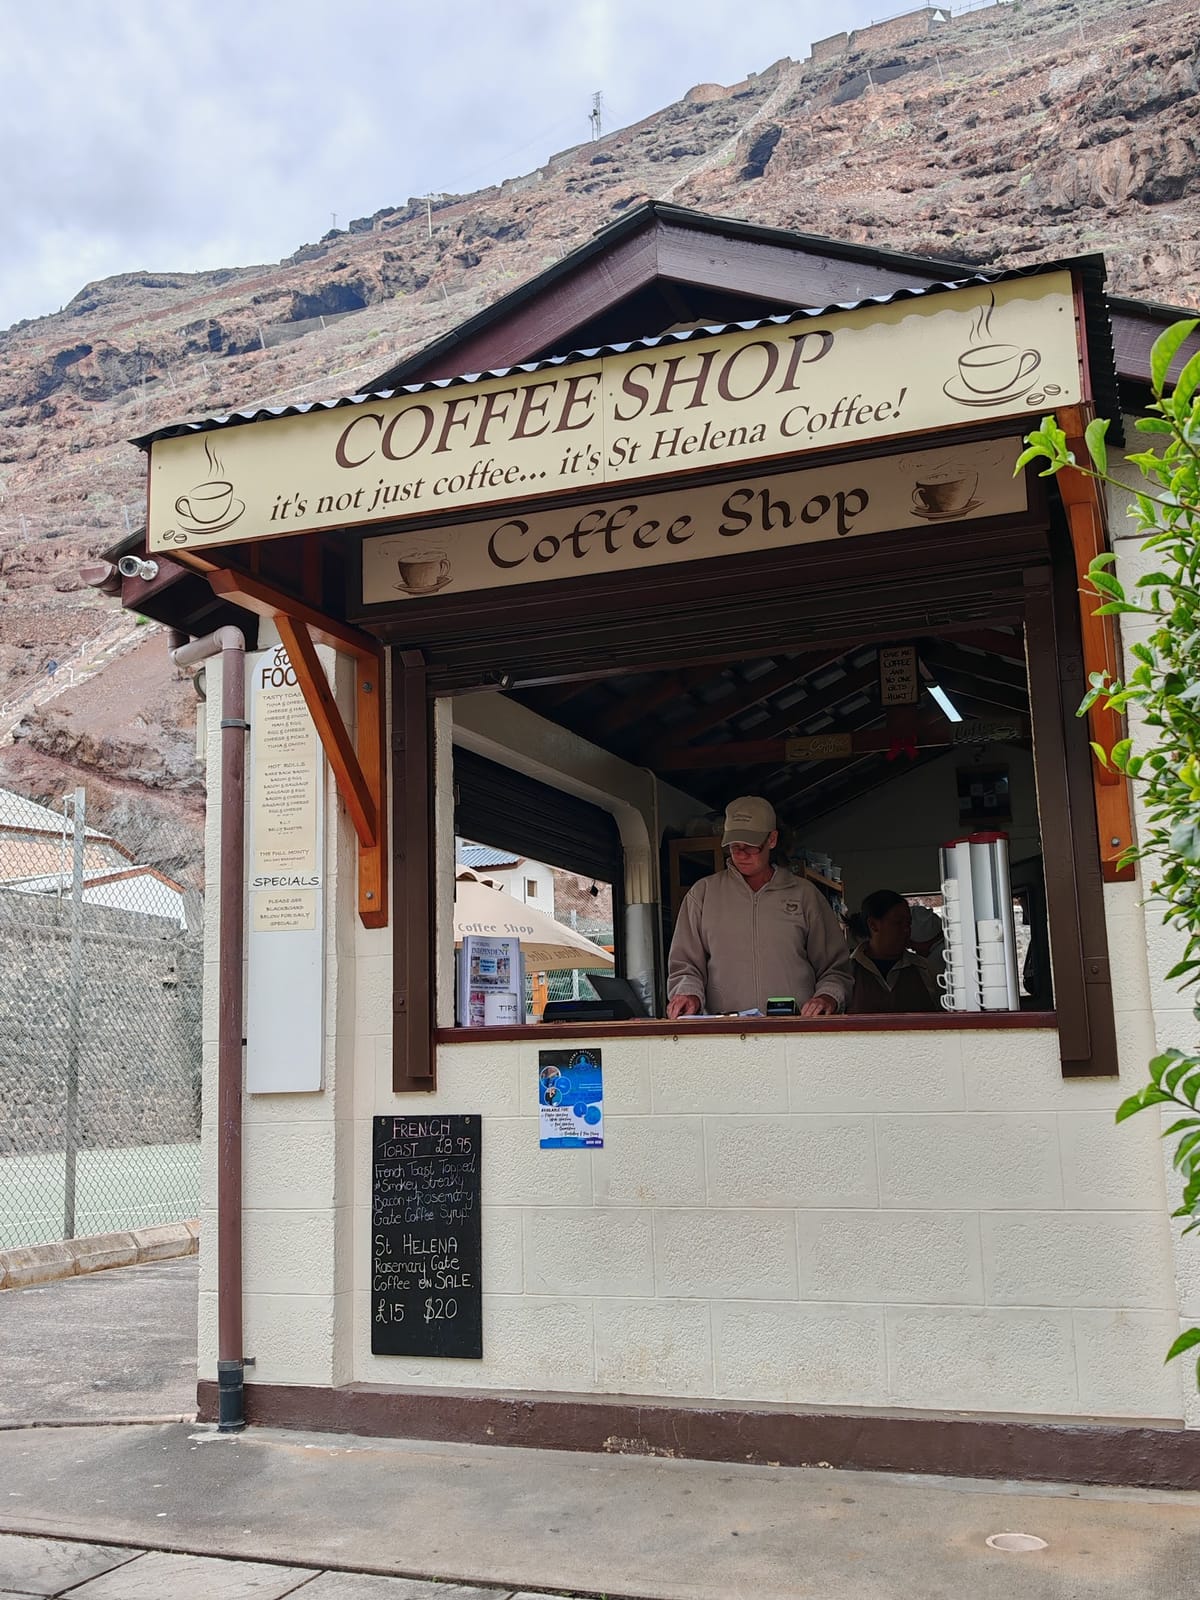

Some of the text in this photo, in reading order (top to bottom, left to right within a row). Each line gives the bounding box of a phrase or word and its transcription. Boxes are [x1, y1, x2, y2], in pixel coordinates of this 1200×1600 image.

[335, 330, 834, 469] COFFEE SHOP
[271, 387, 907, 521] it's not just coffee... it's St Helena Coffee!
[488, 488, 870, 569] Coffee Shop
[262, 667, 298, 689] FOO
[252, 876, 319, 887] SPECIALS
[457, 922, 534, 935] Coffee Shop
[498, 1004, 518, 1012] TIPS
[393, 1118, 451, 1139] FRENCH
[378, 1140, 419, 1158] TOAST
[373, 1194, 405, 1211] Bacon
[373, 1208, 402, 1226] Gate
[374, 1234, 458, 1256] St HELENA
[374, 1255, 461, 1281] Rosemary Gate
[374, 1274, 411, 1292] Coffee
[375, 1296, 458, 1324] £15 $20
